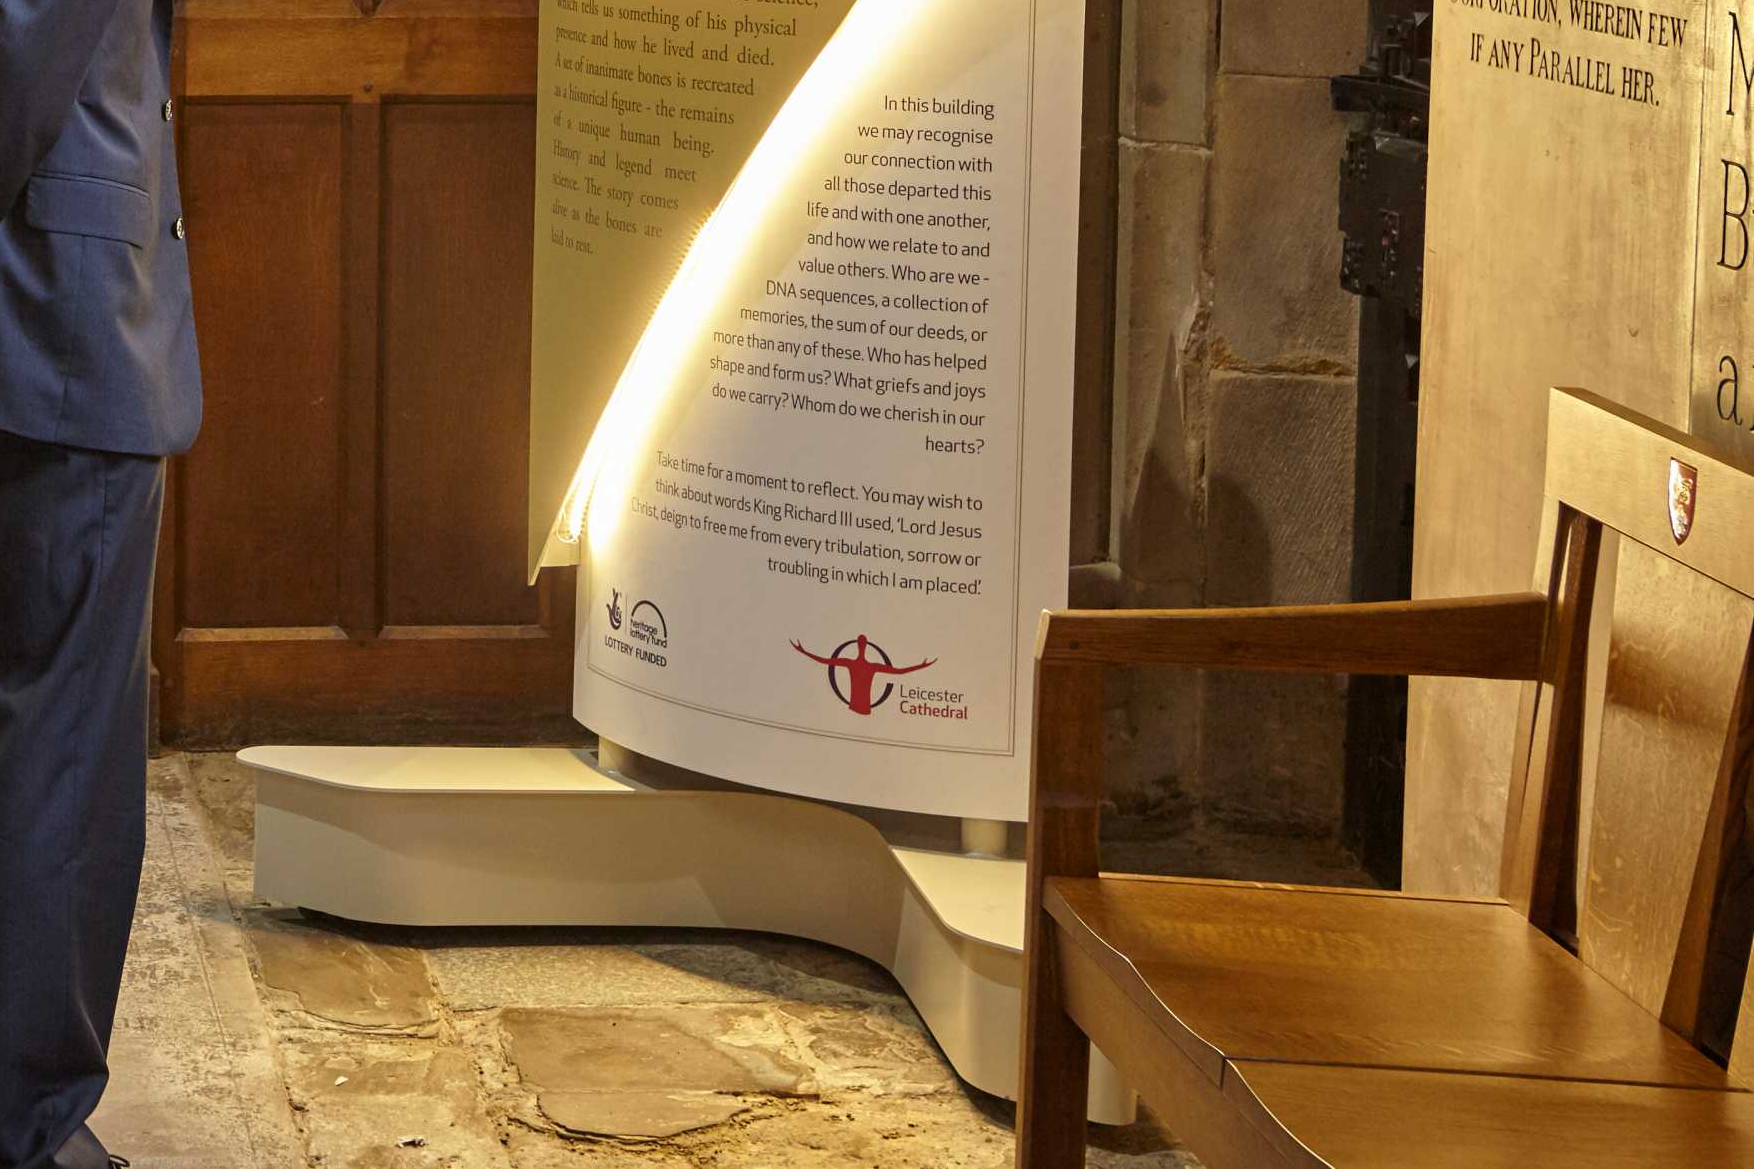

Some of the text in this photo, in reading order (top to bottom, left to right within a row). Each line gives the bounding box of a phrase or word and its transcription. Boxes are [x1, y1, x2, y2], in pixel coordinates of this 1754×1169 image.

[885, 95, 994, 120] In this building
[858, 126, 993, 145] we may recognise
[844, 153, 992, 172] our connection with
[824, 176, 992, 201] all those departed this
[807, 201, 990, 231] life and with one another,
[807, 231, 990, 257] and how we relate to and
[926, 436, 985, 454] hearts?
[768, 558, 829, 584] troubling
[832, 566, 844, 581] in
[846, 569, 888, 586] which
[899, 577, 922, 590] am
[604, 634, 667, 667] LOTTERY FUNDED
[651, 635, 668, 648] fund
[900, 684, 964, 703] Leicester
[900, 700, 967, 720] Cathedral
